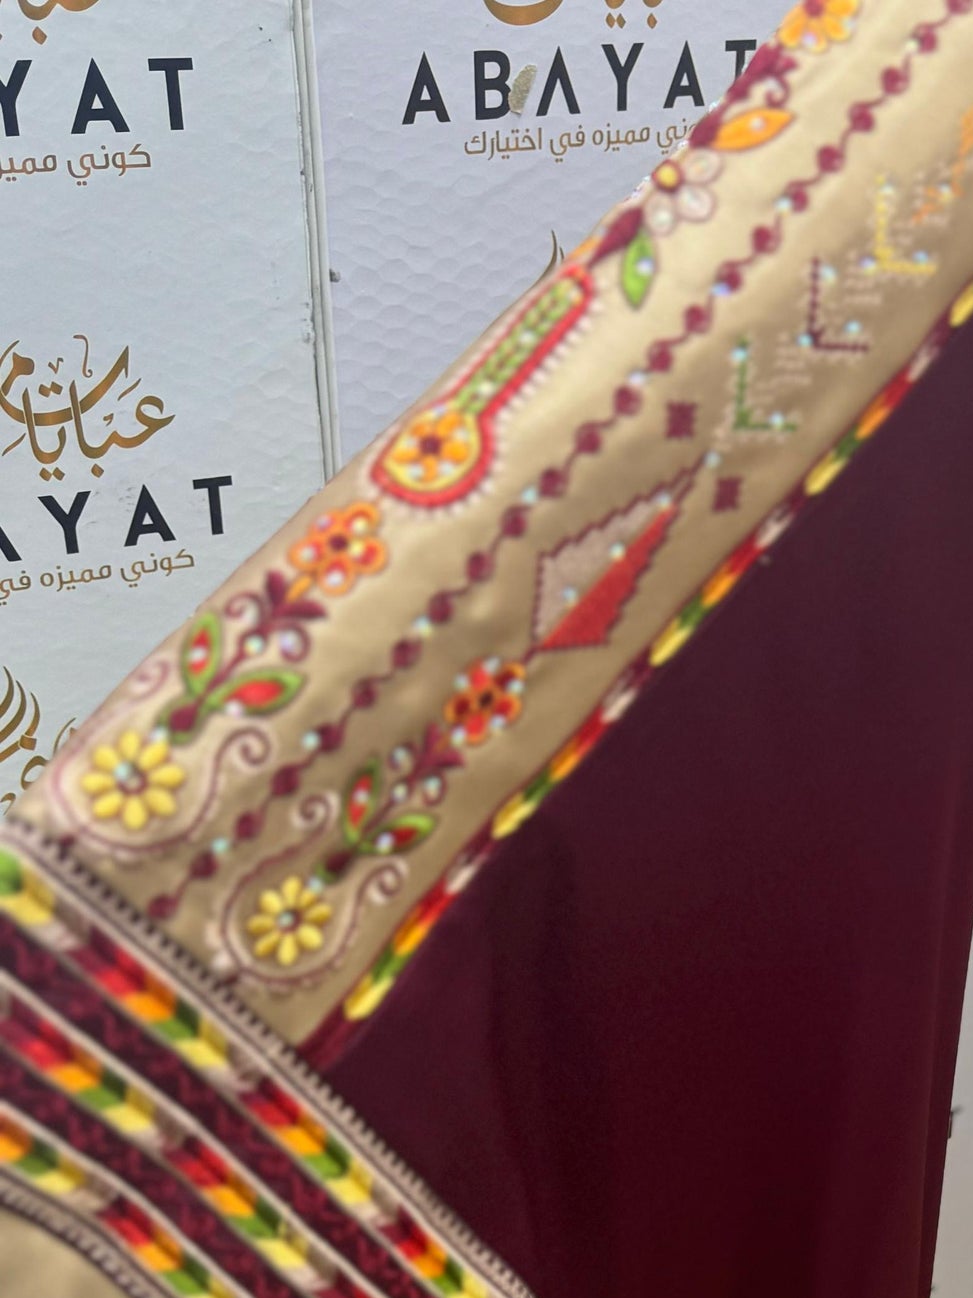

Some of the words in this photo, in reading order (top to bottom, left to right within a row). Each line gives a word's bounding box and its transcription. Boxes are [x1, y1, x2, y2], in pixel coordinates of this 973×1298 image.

[402, 40, 757, 125] ABAYAT
[464, 127, 543, 160] اختيارك
[550, 124, 586, 163] في
[592, 123, 650, 152] مميزه
[67, 143, 151, 186] كوني
[40, 564, 112, 592] مميزه
[120, 549, 195, 588] كوني
